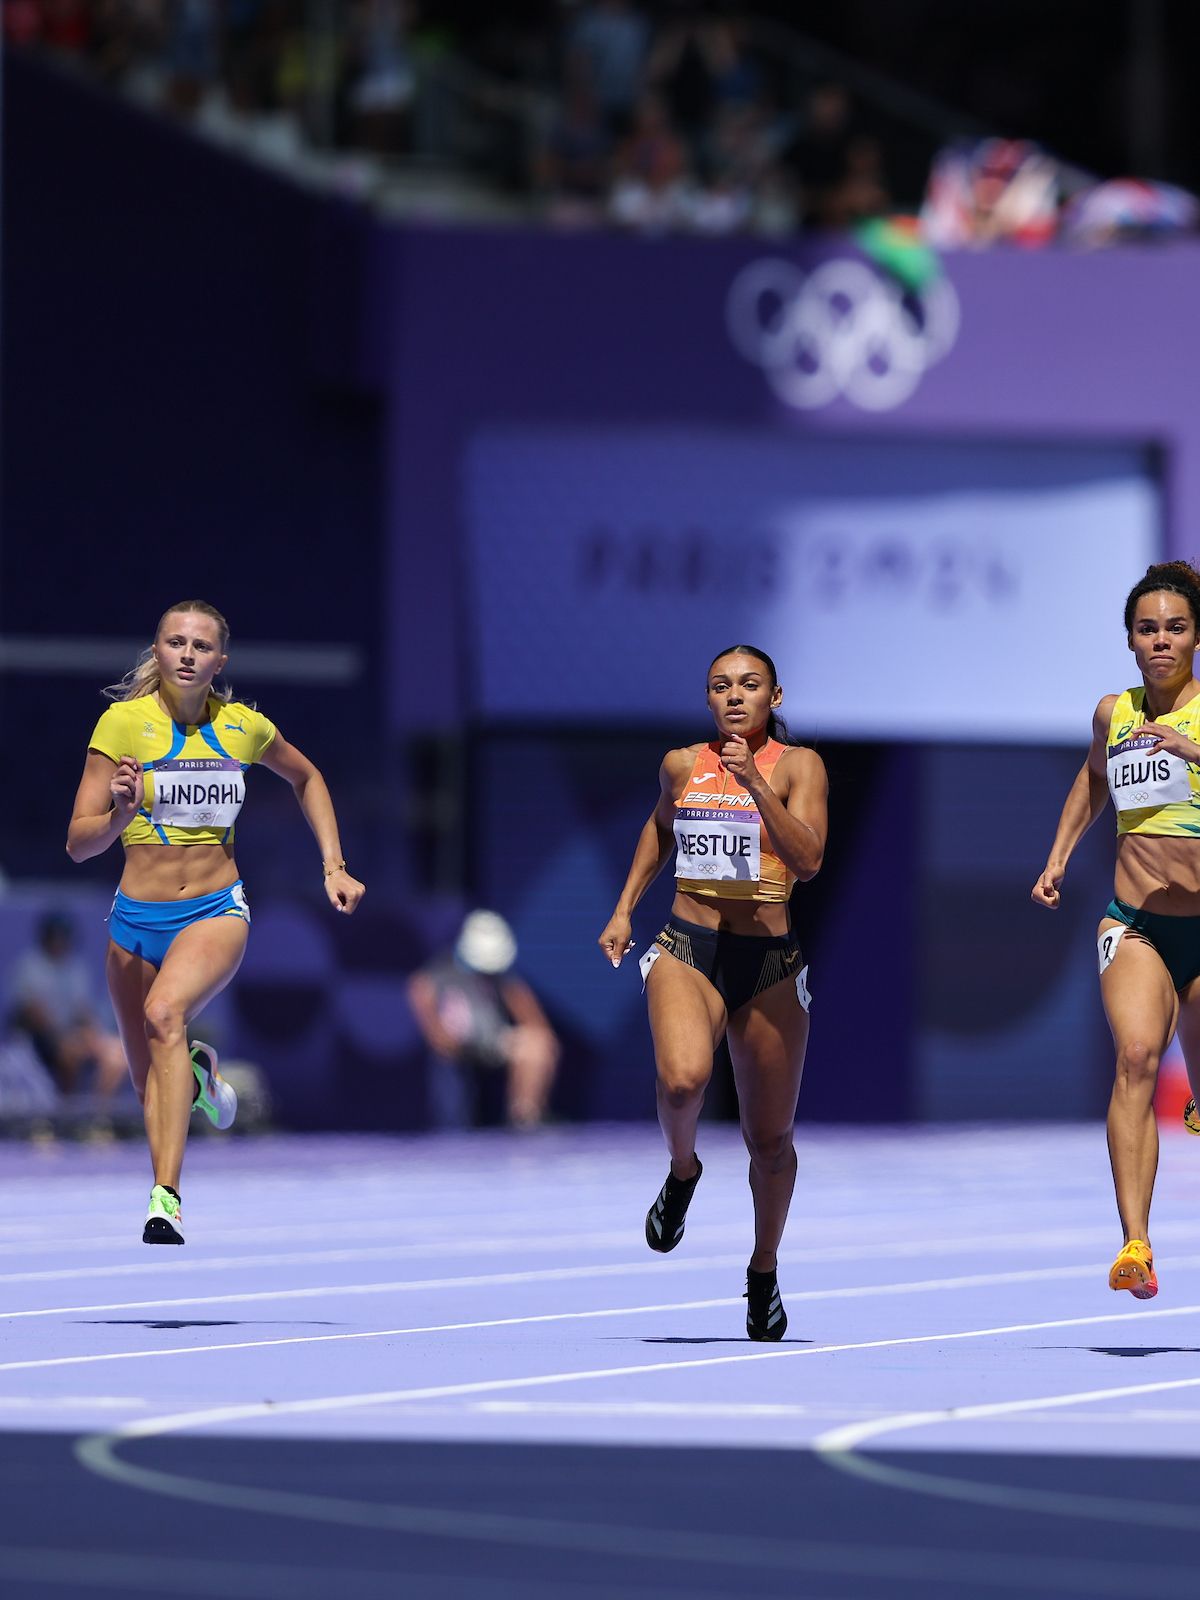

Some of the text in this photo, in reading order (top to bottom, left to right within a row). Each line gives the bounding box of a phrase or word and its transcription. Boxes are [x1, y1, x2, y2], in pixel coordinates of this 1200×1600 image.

[1114, 759, 1170, 789] LEWIS
[160, 784, 242, 804] LINDAHL
[712, 811, 734, 819] 2024
[679, 833, 751, 857] BESTUE
